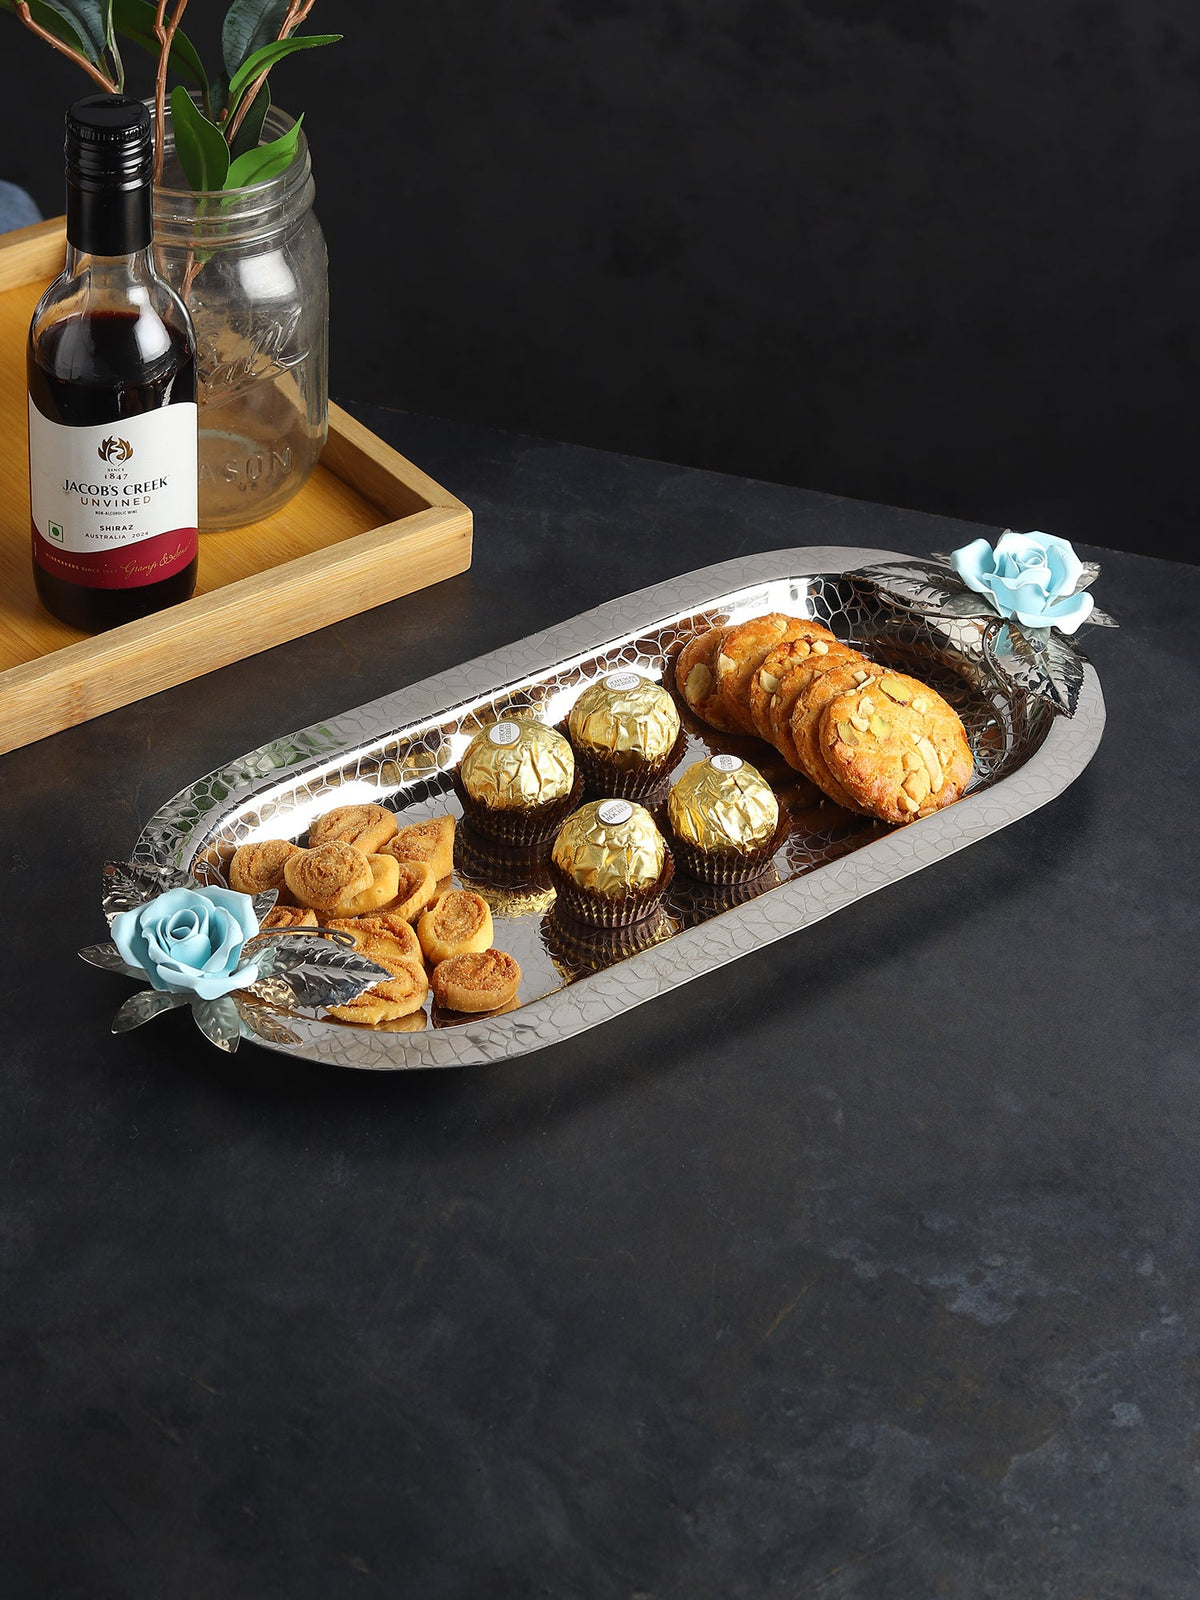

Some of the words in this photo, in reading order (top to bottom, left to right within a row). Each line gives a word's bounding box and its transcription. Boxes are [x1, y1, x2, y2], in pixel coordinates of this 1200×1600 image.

[199, 446, 293, 487] ASON
[63, 479, 119, 496] JACOB'S
[123, 475, 169, 496] CREEK
[80, 495, 152, 508] UNVINED
[99, 524, 134, 532] SHIRAZ
[131, 531, 149, 539] 2024
